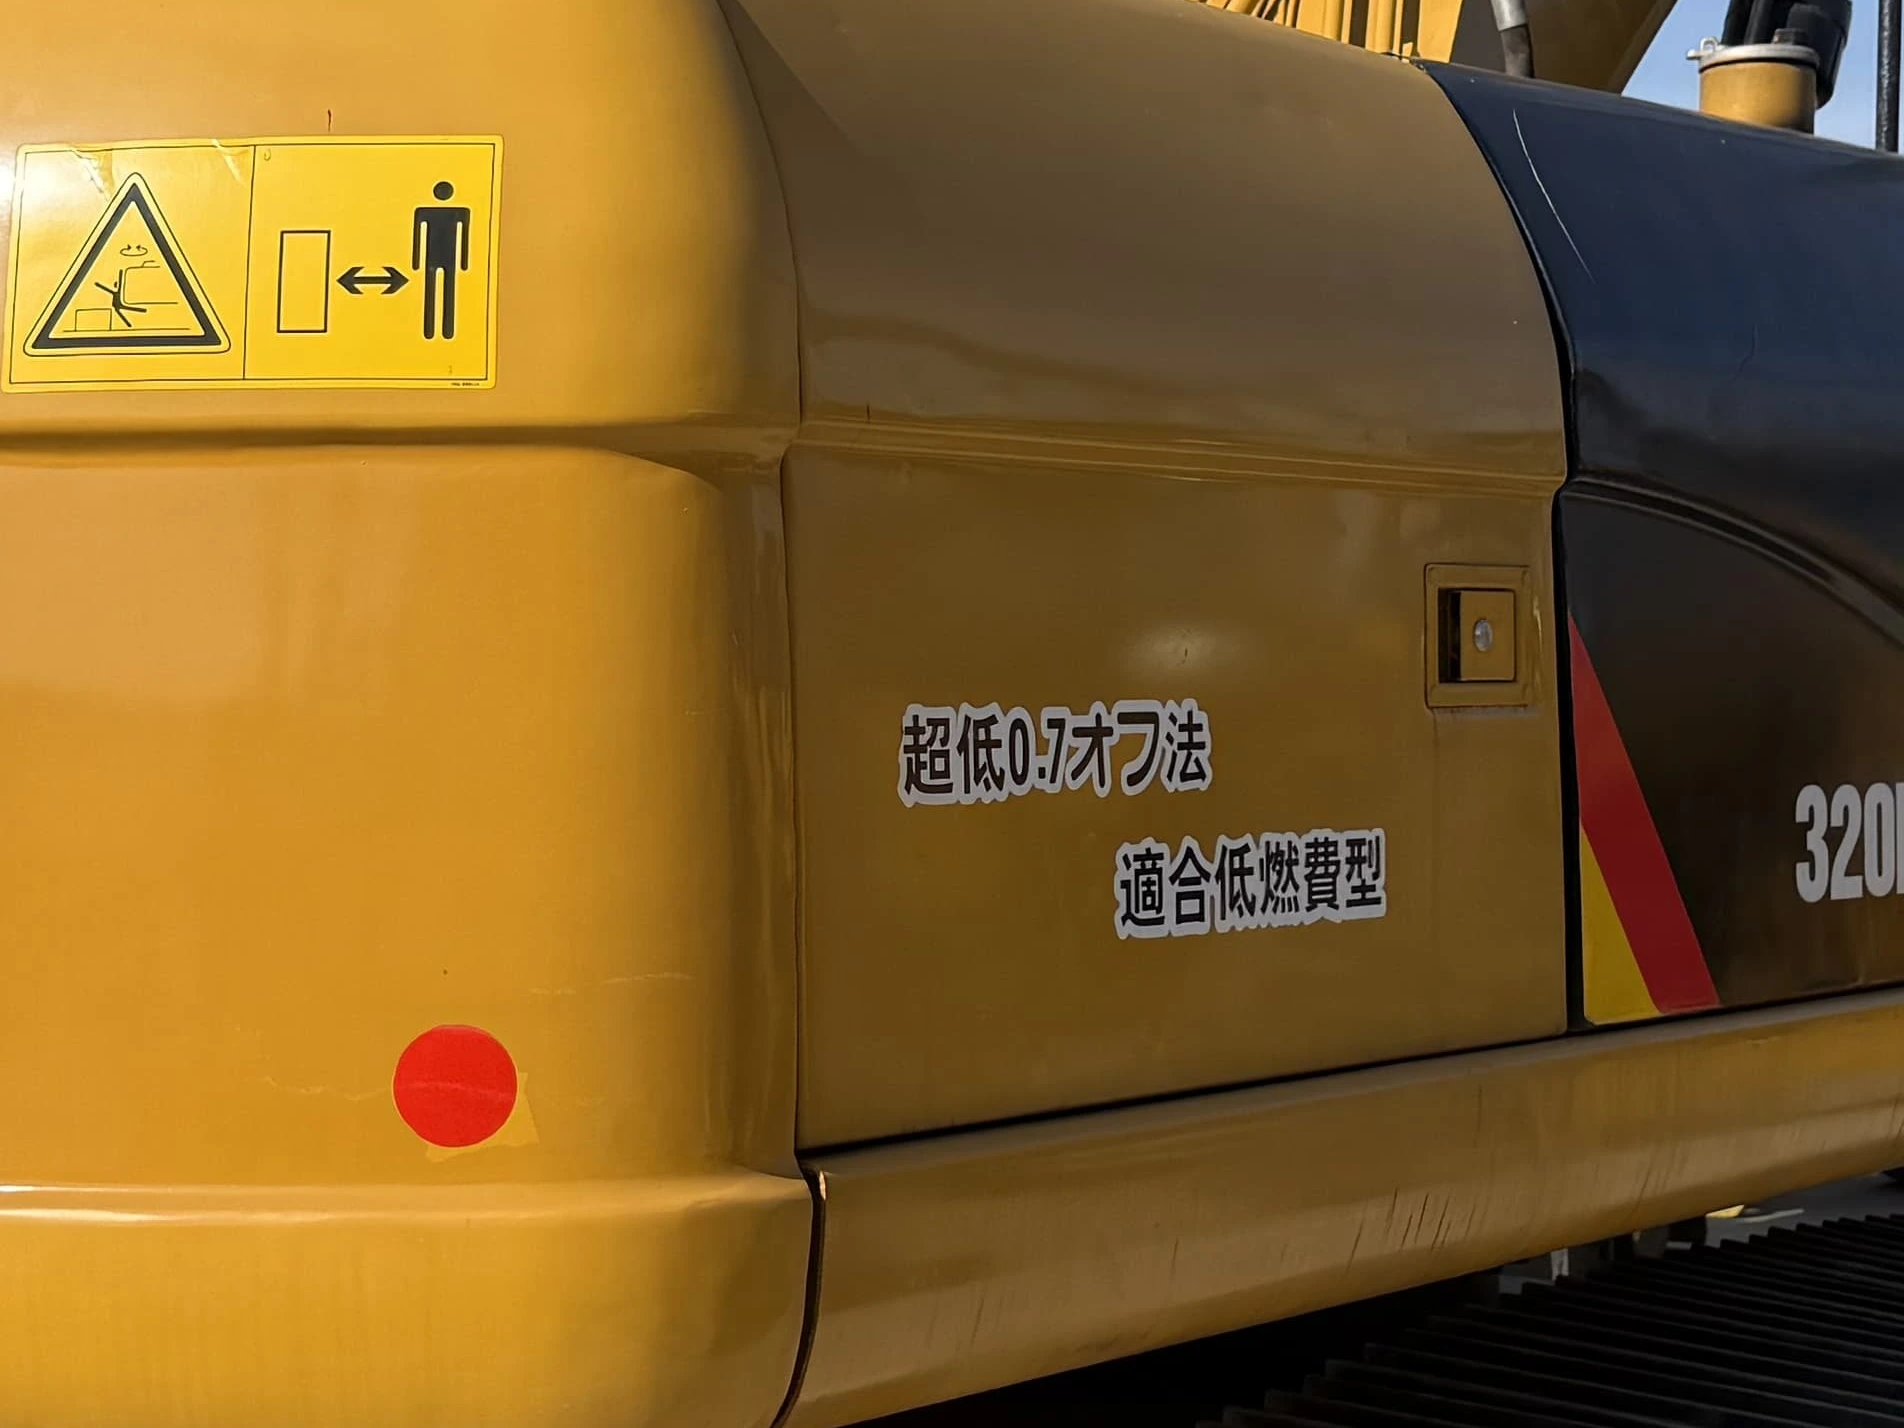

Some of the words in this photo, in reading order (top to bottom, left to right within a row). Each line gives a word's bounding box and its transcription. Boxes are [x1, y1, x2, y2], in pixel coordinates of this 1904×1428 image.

[1118, 834, 1383, 929] 適合低燃費型
